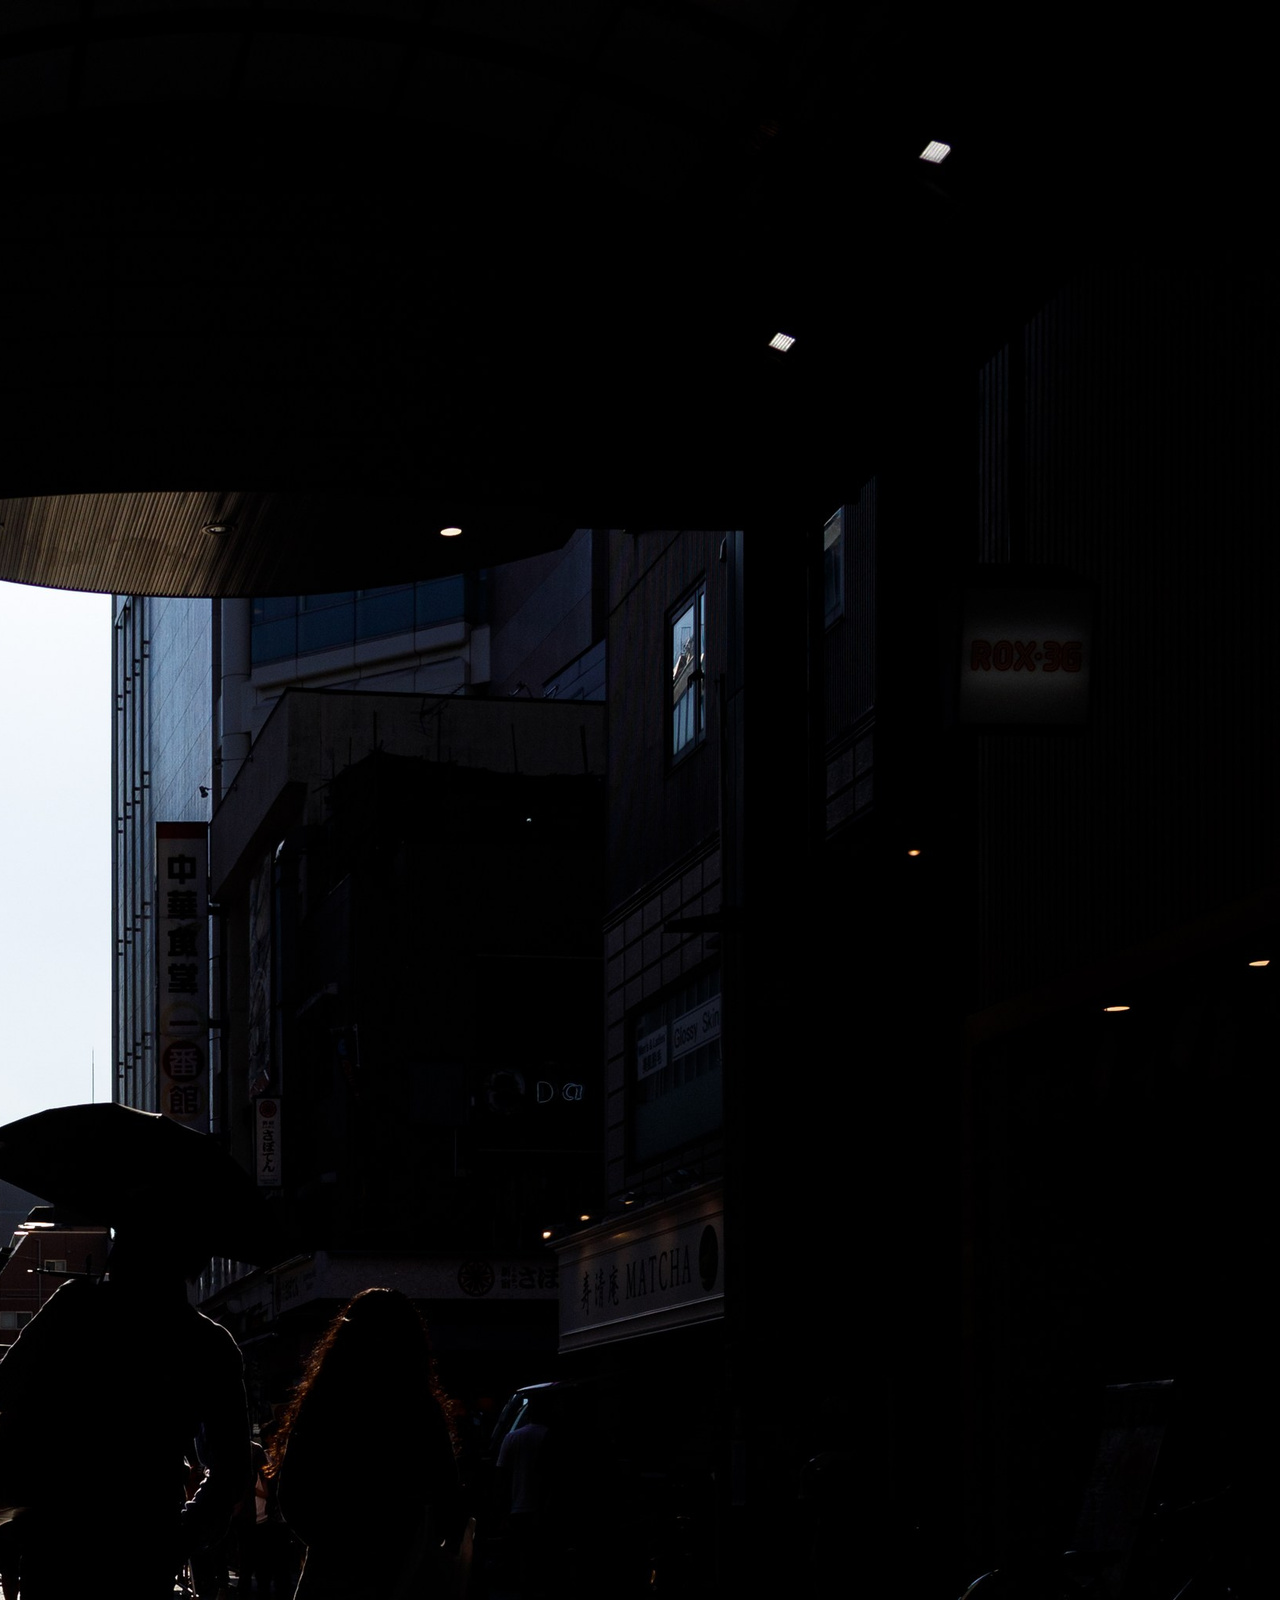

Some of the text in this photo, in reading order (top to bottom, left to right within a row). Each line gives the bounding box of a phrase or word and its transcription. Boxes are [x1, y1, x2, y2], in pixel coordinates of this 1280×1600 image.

[168, 854, 199, 1114] 中華食堂一番館
[626, 1245, 692, 1300] MATCHA
